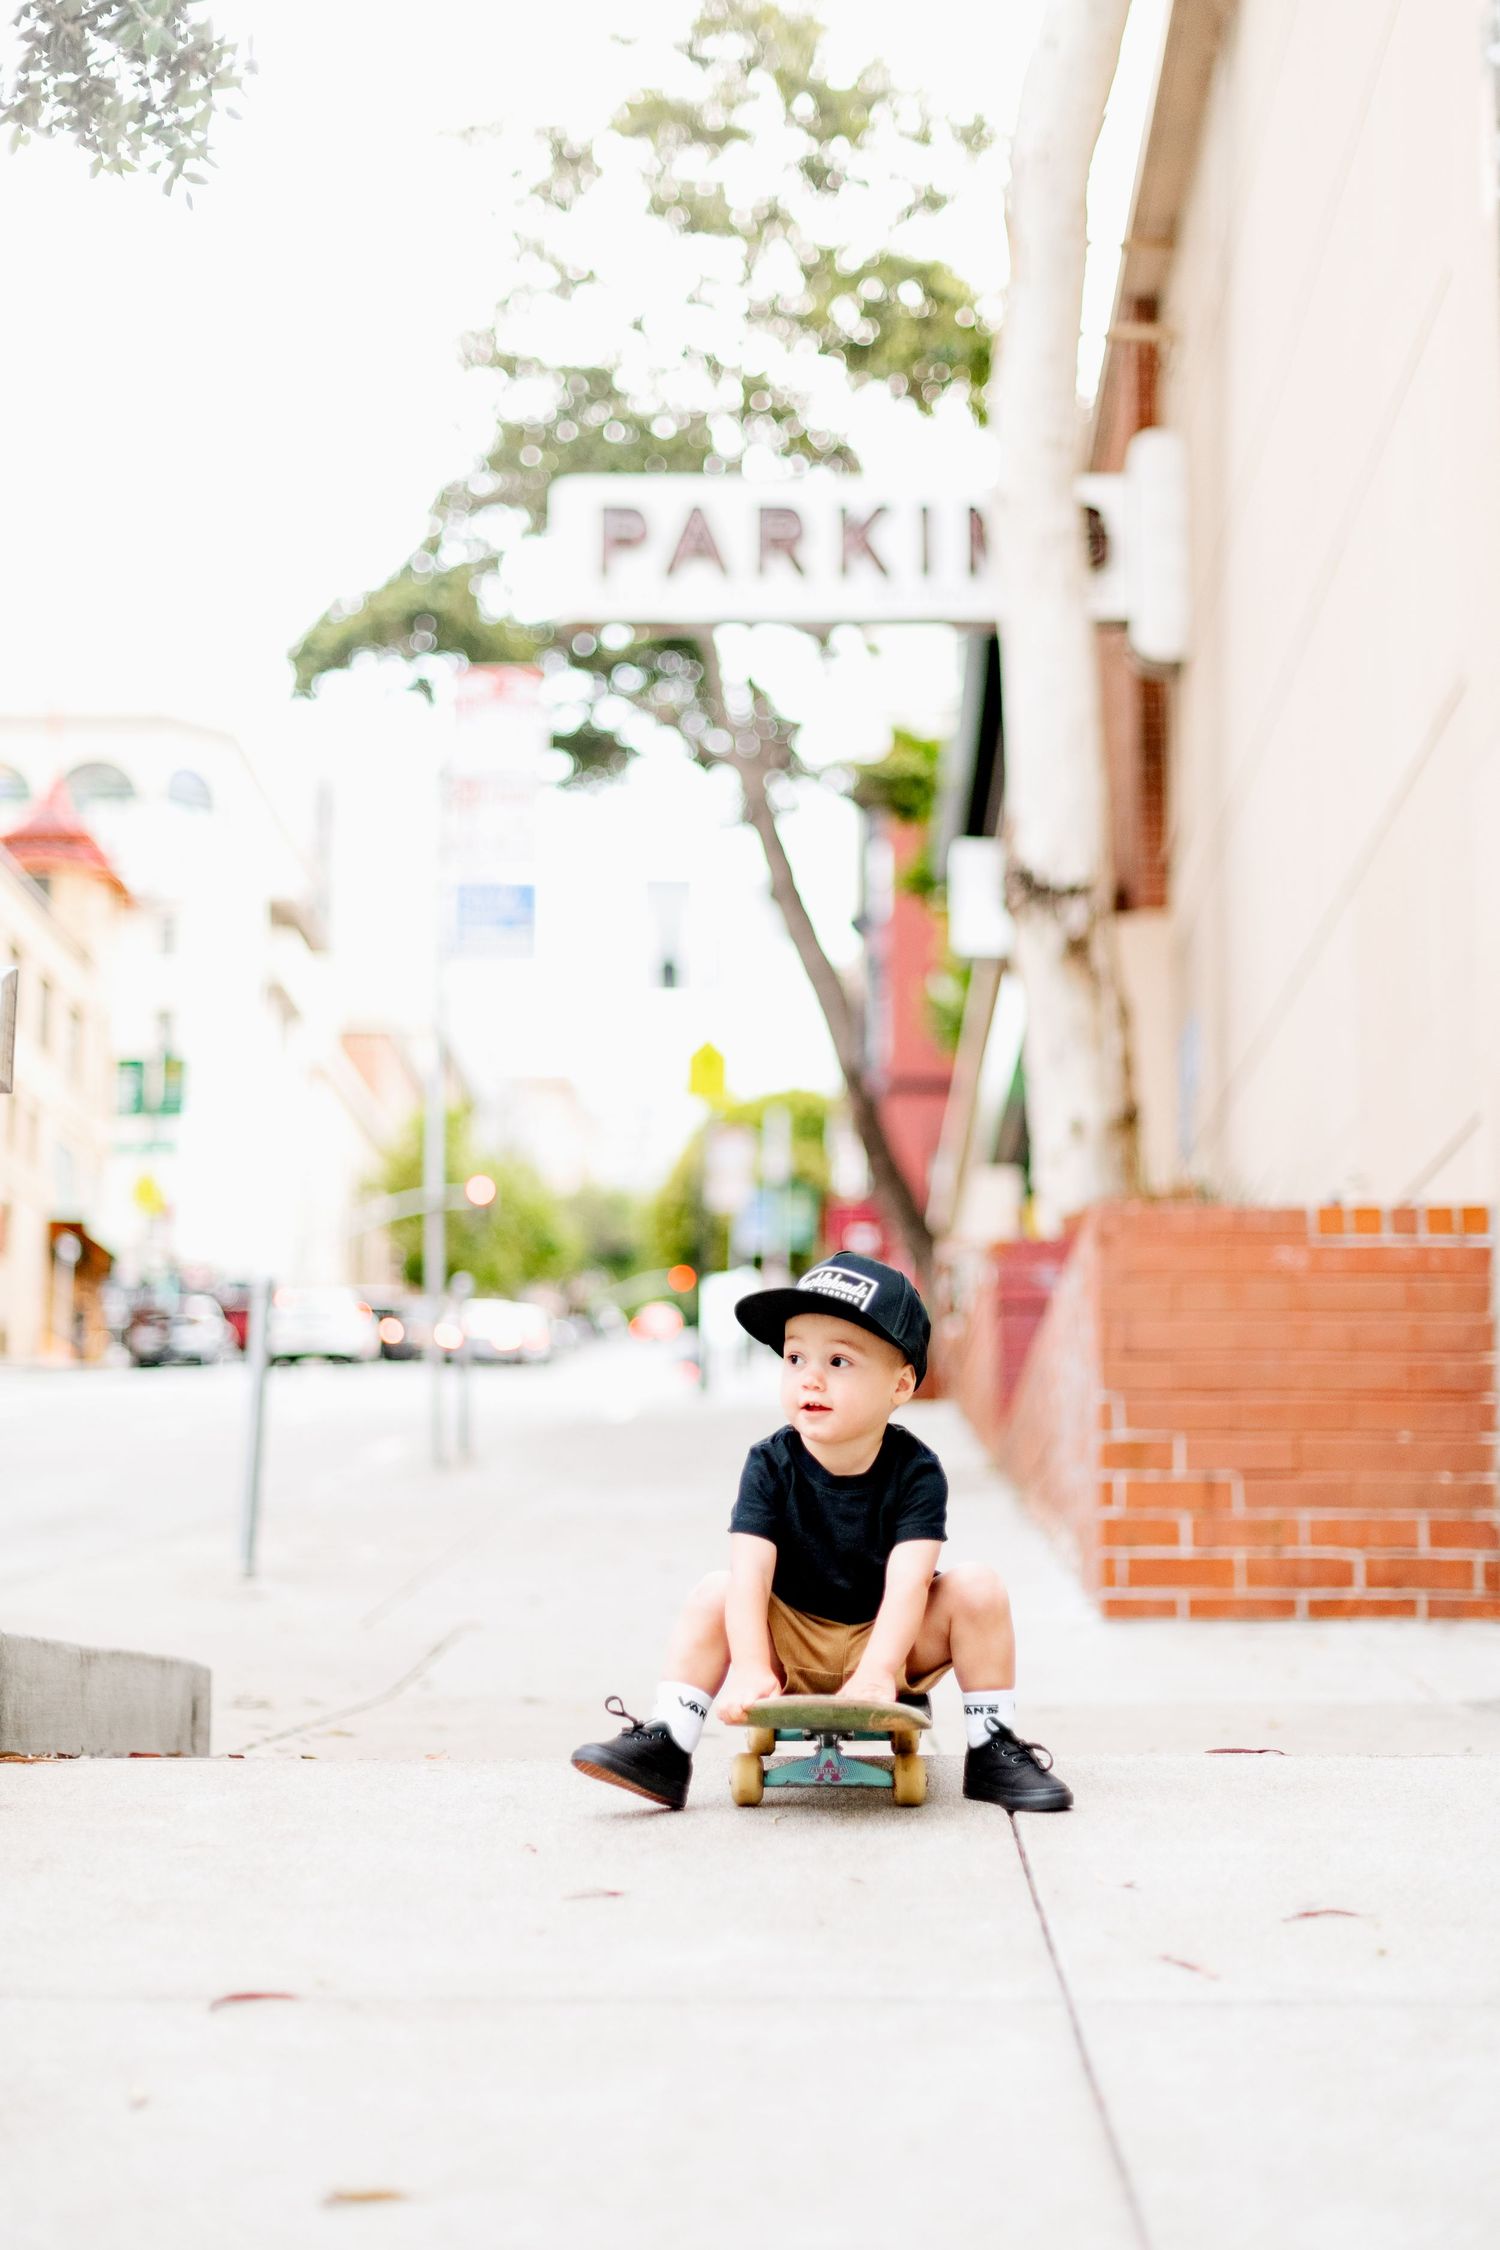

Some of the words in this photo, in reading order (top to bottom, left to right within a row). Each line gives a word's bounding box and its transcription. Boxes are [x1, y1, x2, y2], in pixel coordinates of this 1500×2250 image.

[601, 505, 1109, 576] PARKI
[678, 1695, 708, 1721] VAN
[964, 1704, 999, 1716] ANS
